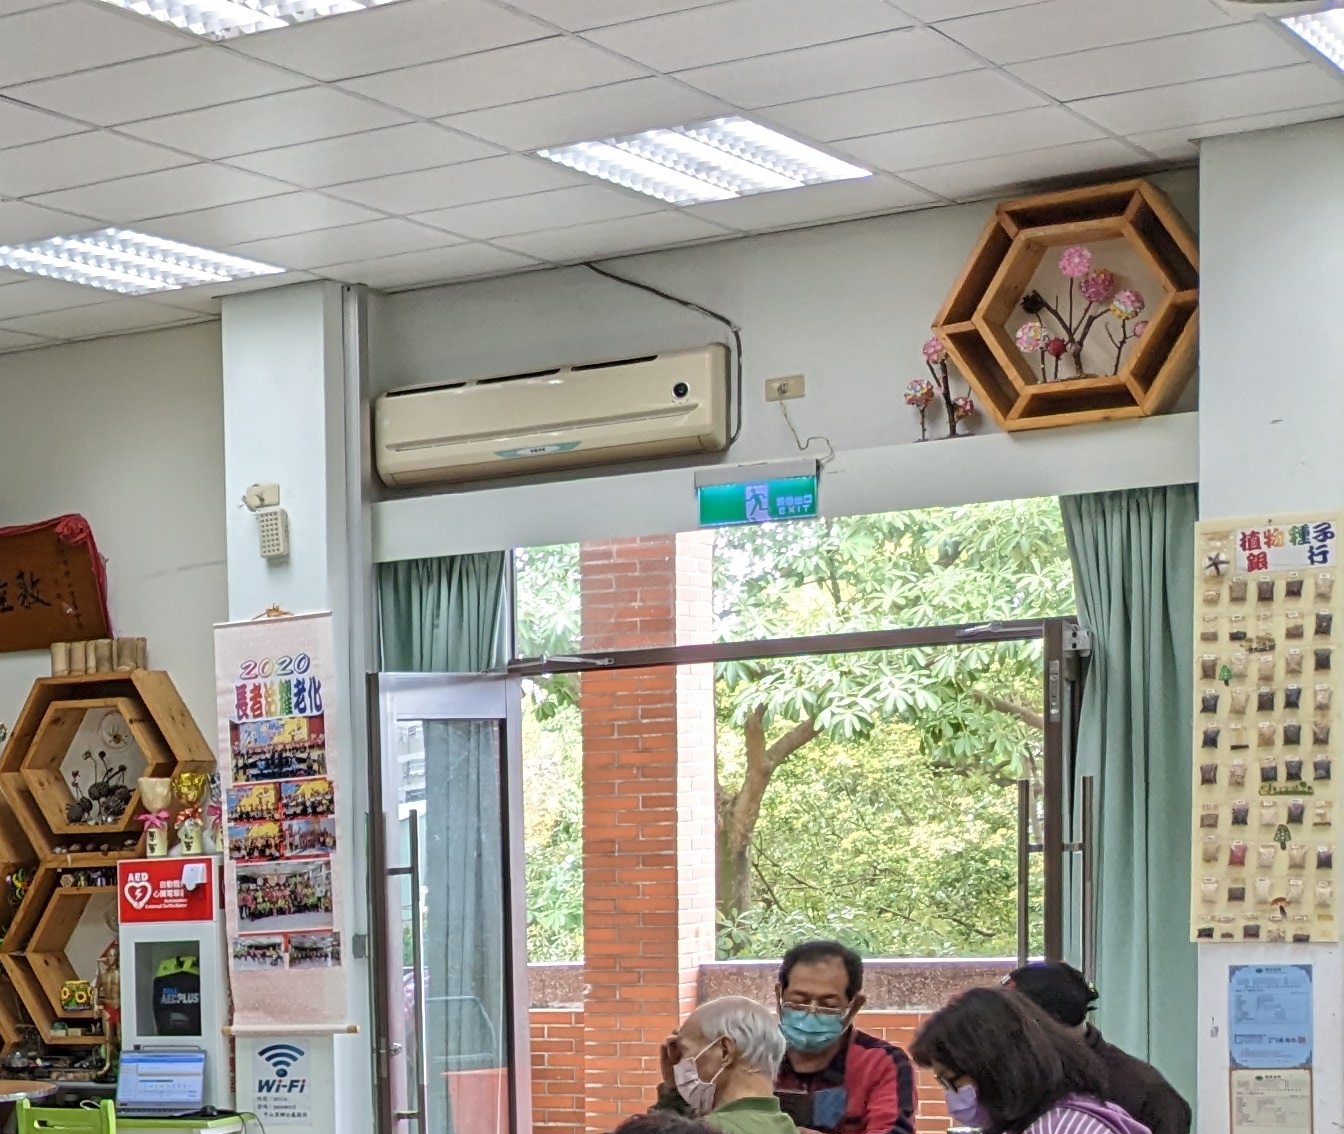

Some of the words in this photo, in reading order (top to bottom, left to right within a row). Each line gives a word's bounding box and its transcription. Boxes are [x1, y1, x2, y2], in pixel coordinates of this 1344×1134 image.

[778, 505, 810, 515] EXIT
[1240, 522, 1336, 552] 植物種子
[240, 653, 310, 680] 2020
[128, 872, 149, 882] AED
[257, 1079, 306, 1093] Wi-Fi
